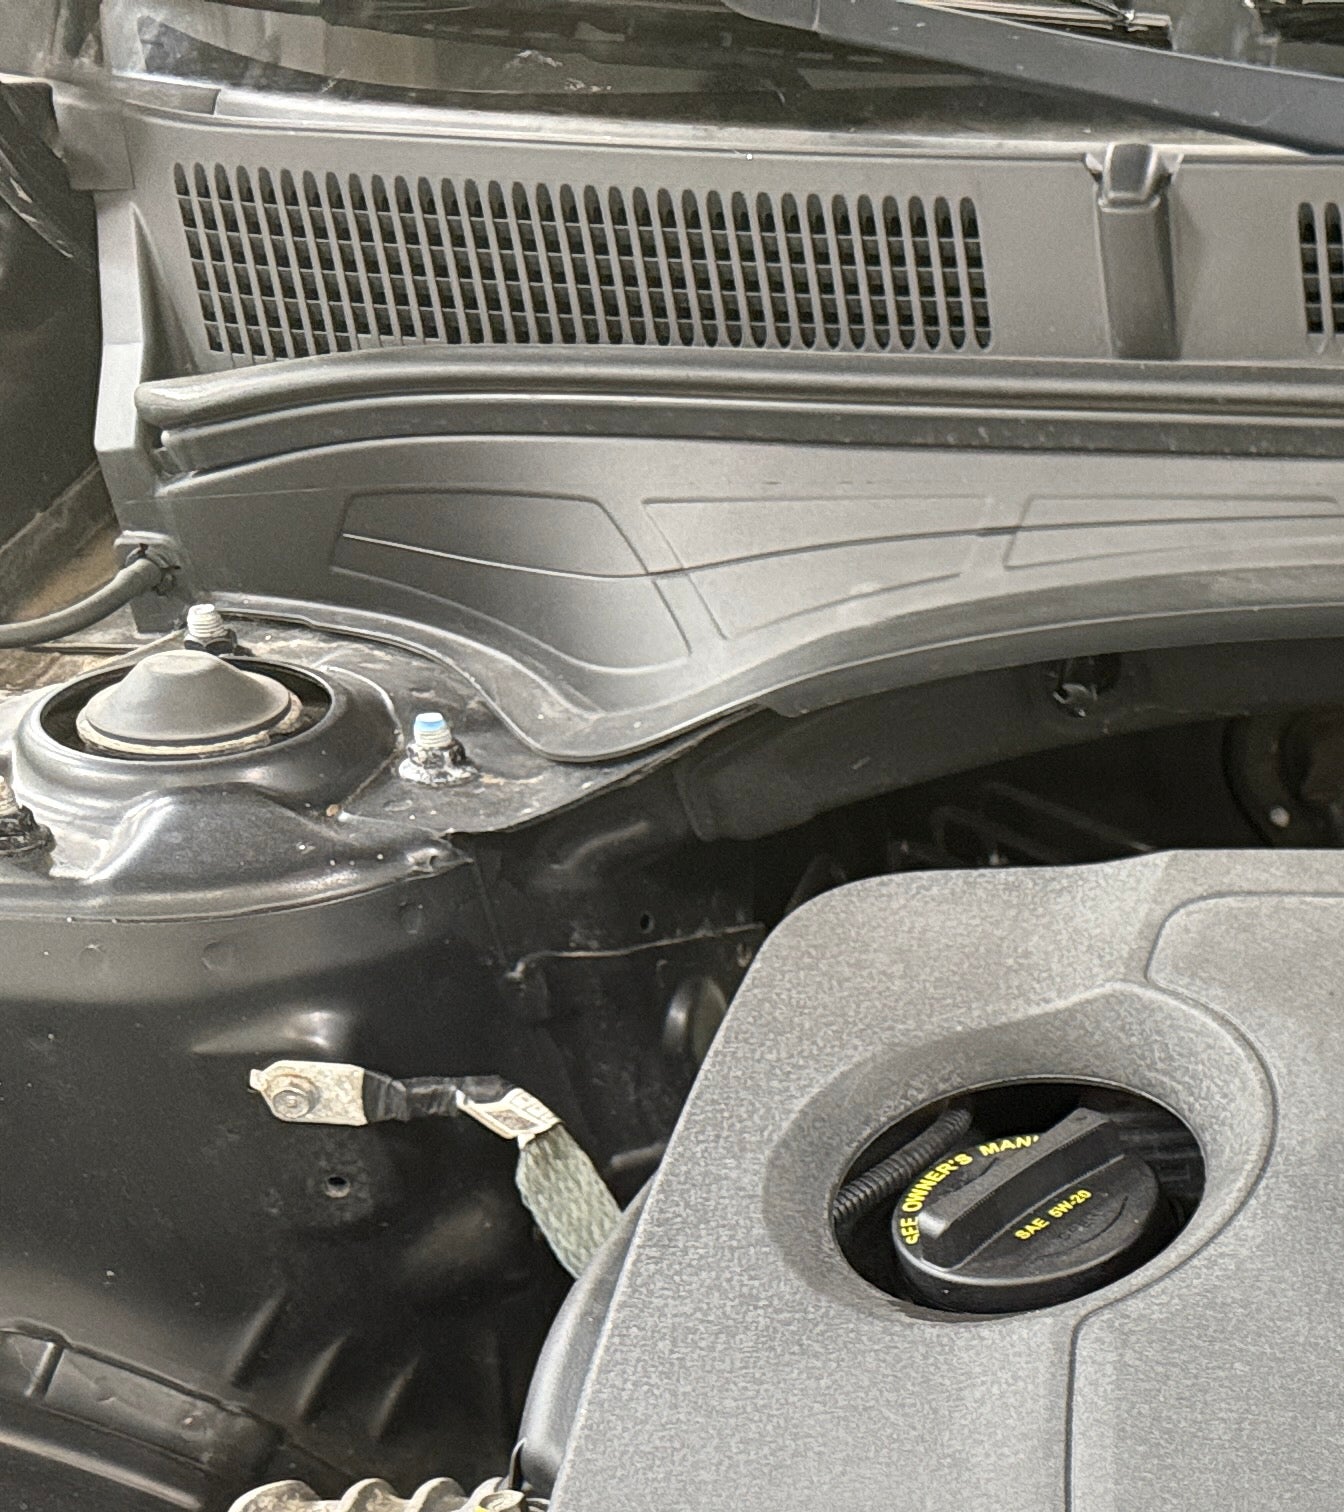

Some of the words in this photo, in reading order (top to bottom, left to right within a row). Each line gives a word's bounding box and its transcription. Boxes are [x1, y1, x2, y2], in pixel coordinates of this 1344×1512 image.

[901, 1153, 973, 1213] OWNER'S
[1014, 1217, 1051, 1240] SAE
[1047, 1189, 1093, 1218] 5W-20
